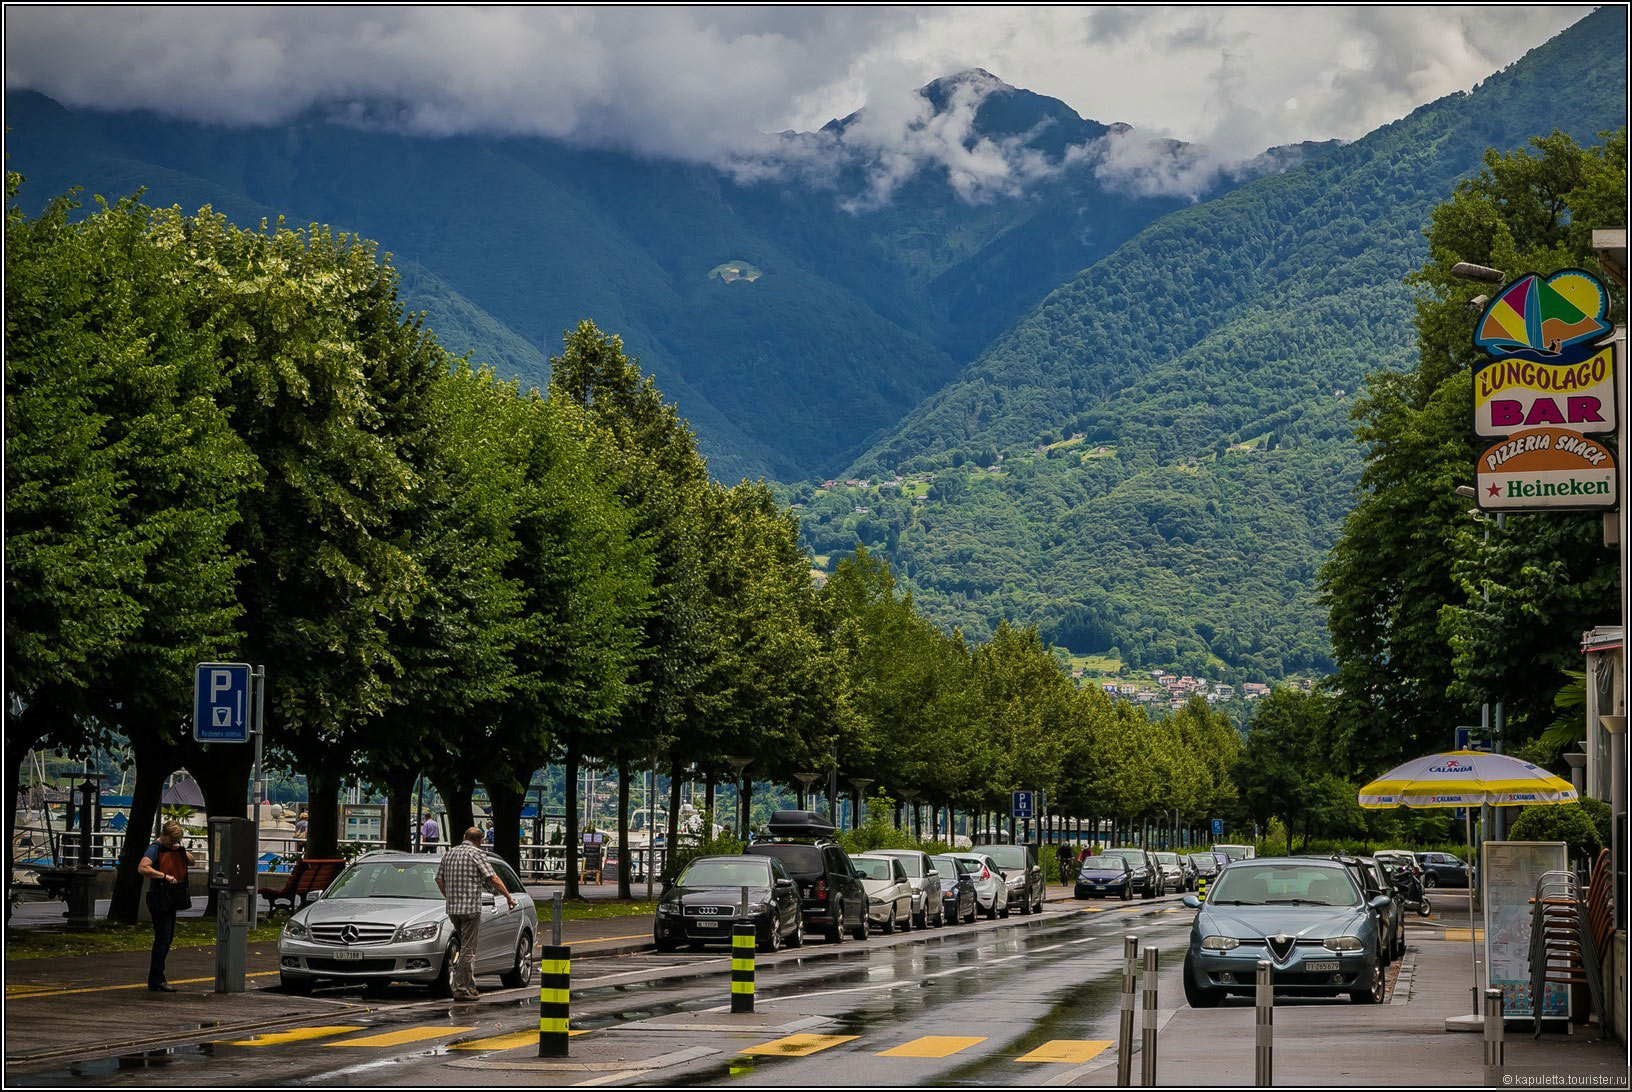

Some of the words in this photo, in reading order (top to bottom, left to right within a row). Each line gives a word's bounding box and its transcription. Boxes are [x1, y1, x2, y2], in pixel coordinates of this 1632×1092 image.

[1481, 355, 1606, 398] LUNGOLAGO
[1490, 396, 1607, 427] BAR
[1486, 433, 1551, 471] PIZZERIA
[1555, 435, 1607, 466] SNACK
[1507, 478, 1610, 498] Heineken
[210, 669, 232, 703] P
[1428, 765, 1473, 773] CALANDA
